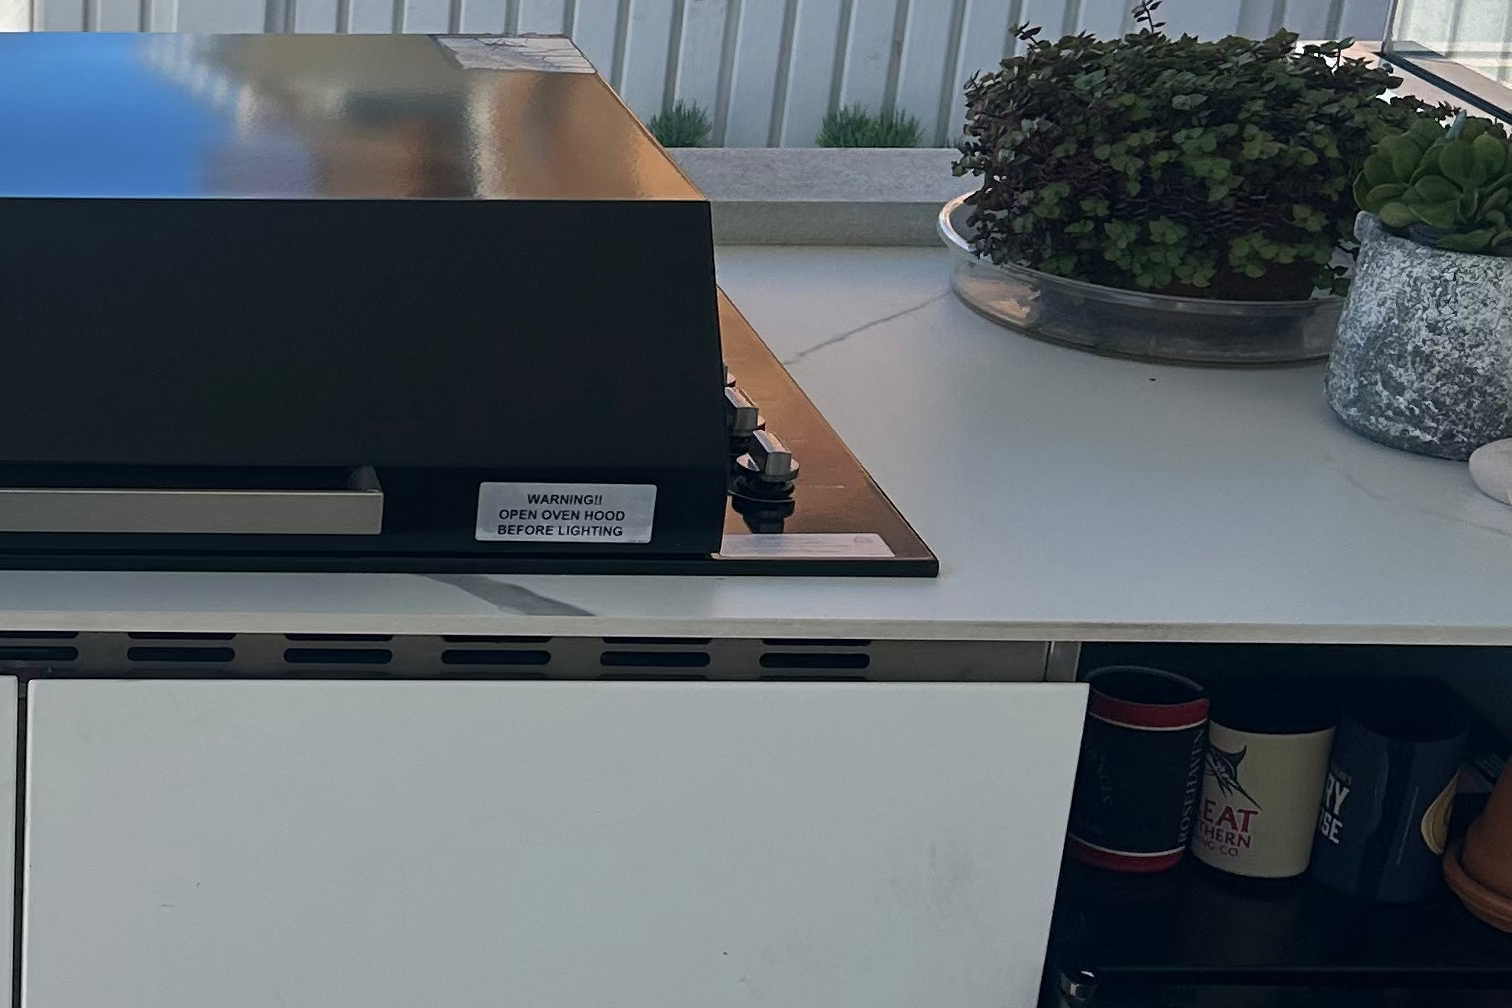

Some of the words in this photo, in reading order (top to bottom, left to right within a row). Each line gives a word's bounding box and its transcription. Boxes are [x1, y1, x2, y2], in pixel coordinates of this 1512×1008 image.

[528, 494, 603, 505] WARNING!!
[498, 509, 537, 520] OPEN
[542, 510, 580, 521] OVEN
[584, 510, 626, 521] HOOD
[497, 524, 554, 536] BEFORE
[558, 525, 623, 537] LIGHTING
